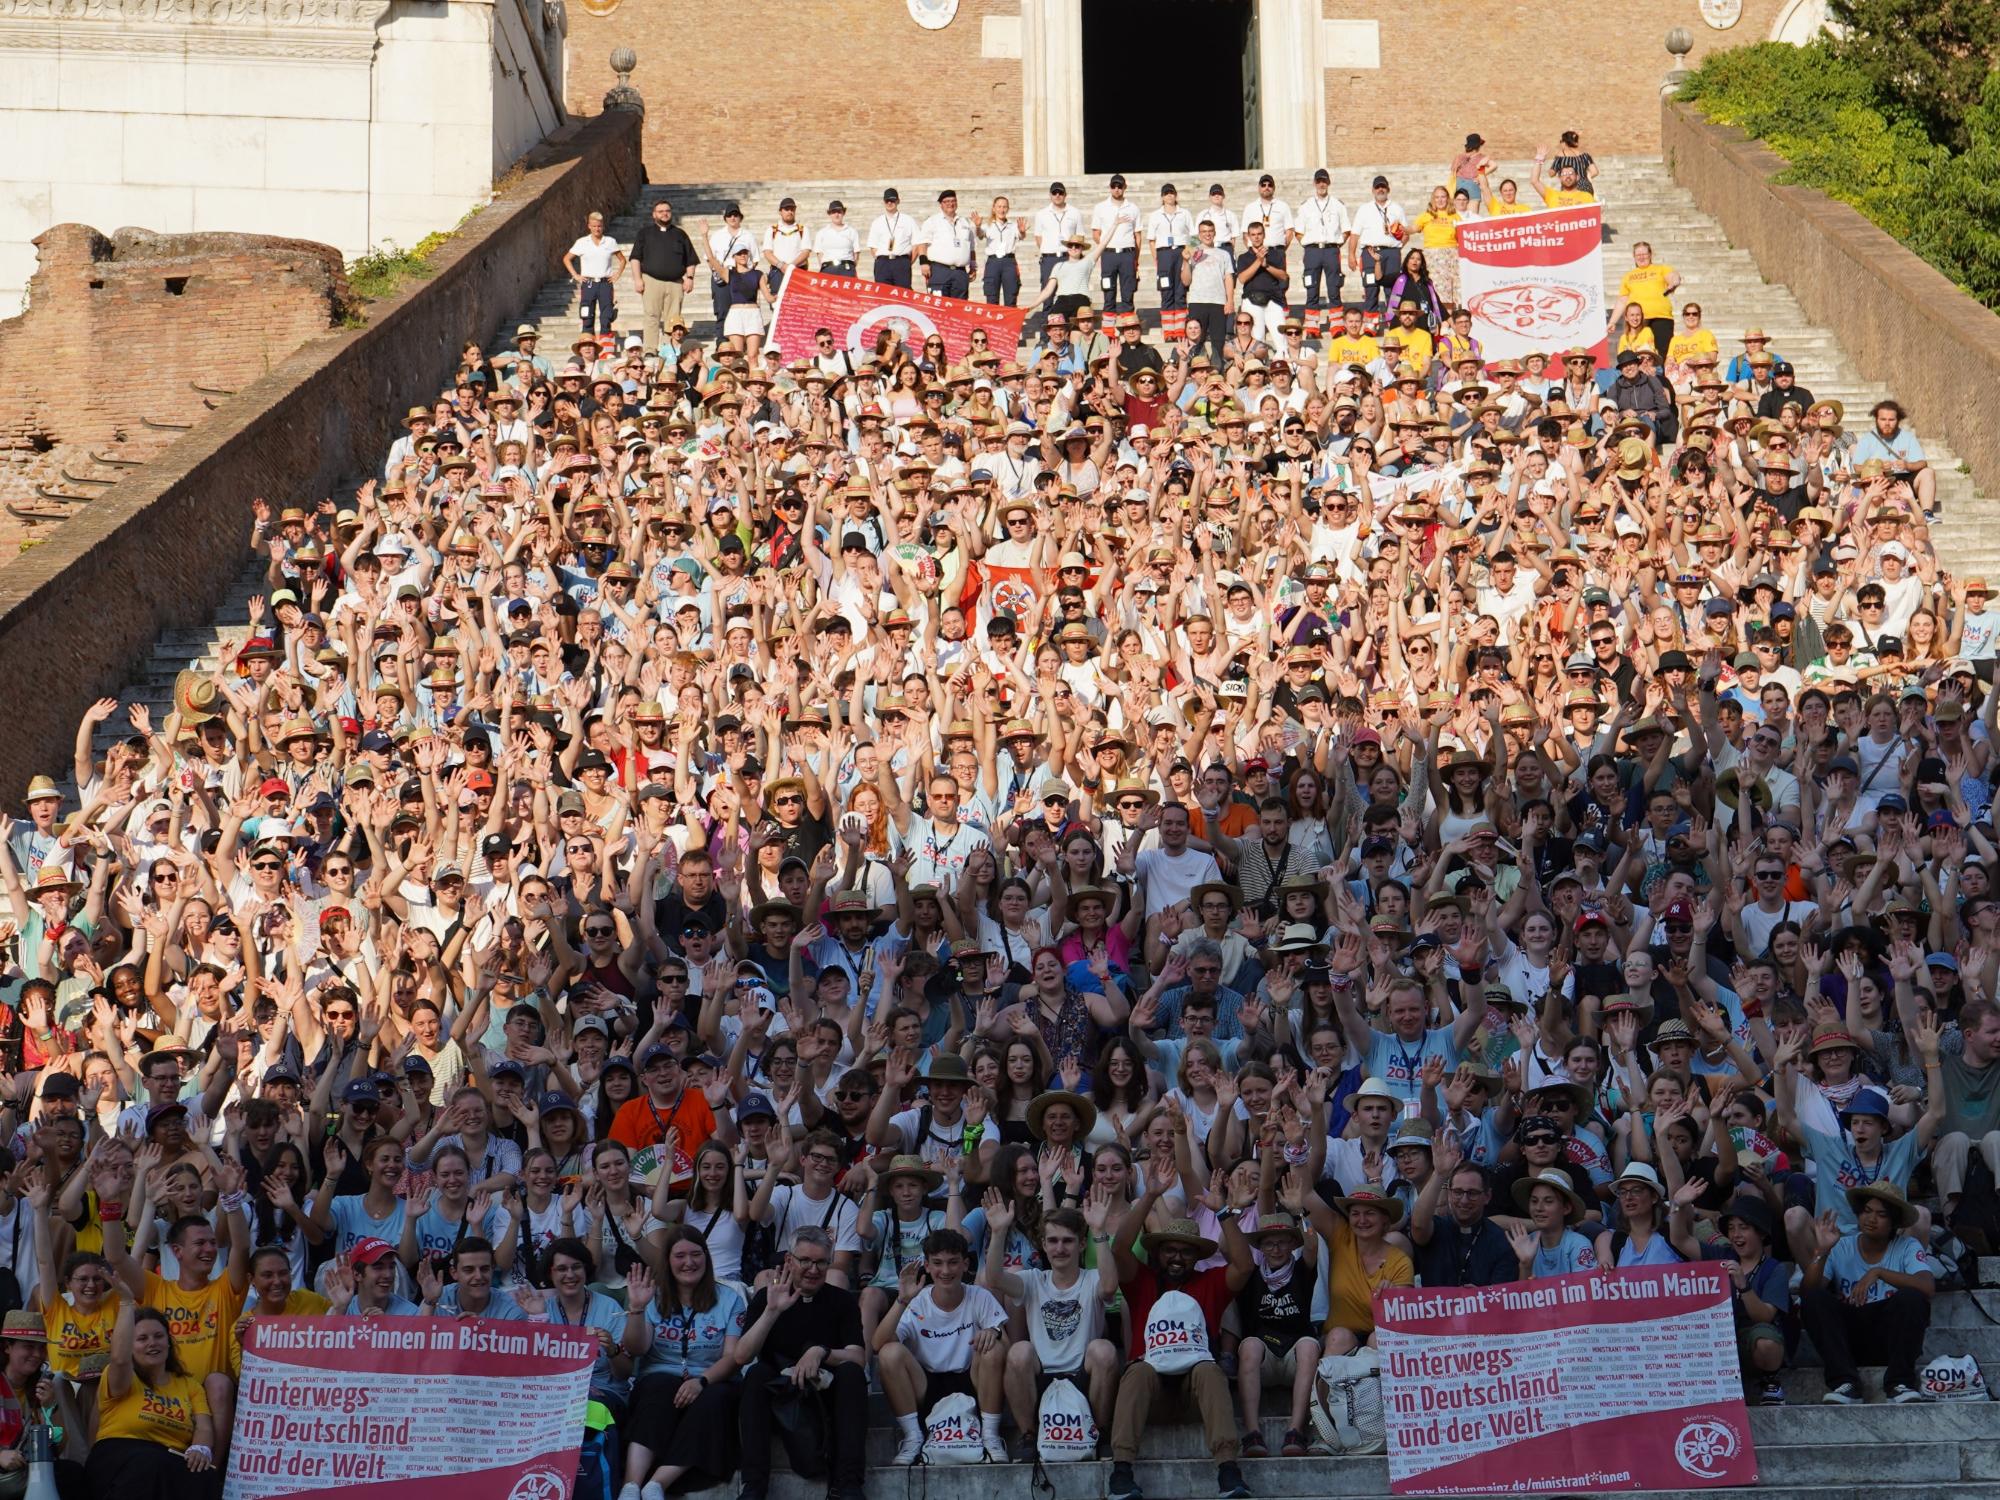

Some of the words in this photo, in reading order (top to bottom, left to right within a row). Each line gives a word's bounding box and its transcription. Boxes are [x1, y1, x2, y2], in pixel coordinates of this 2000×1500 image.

[1464, 240, 1516, 252] Bistum
[1520, 236, 1564, 248] Mainz
[810, 278, 880, 293] PFARREI
[891, 288, 953, 308] ALFRED
[964, 305, 1004, 320] DELP
[1670, 904, 1680, 913] NY
[1386, 1067, 1423, 1080] 204
[1567, 1141, 1590, 1160] 2024
[634, 1150, 655, 1171] ROM
[1837, 1169, 1856, 1187] 20
[1561, 1280, 1587, 1304] im
[1590, 1274, 1659, 1300] Bistum
[1663, 1270, 1720, 1297] Mainz
[164, 1307, 200, 1320] ROM
[169, 1321, 200, 1335] 024
[656, 1326, 696, 1340] 204
[1149, 1320, 1184, 1336] ROM
[59, 1335, 100, 1350] 2024
[430, 1326, 454, 1349] im
[459, 1327, 528, 1354] Bistum
[533, 1333, 590, 1359] Mainz
[1149, 1331, 1188, 1350] 2024
[1390, 1348, 1513, 1378] Unterwegs
[1926, 1369, 1965, 1381] ROM
[1394, 1386, 1415, 1412] in
[1421, 1368, 1560, 1408] Deutschland
[1926, 1379, 1966, 1392] 2024
[249, 1378, 370, 1414] Unterwegs
[142, 1400, 185, 1422] 2024
[1043, 1413, 1081, 1427] ROM
[243, 1410, 264, 1438] in
[271, 1414, 410, 1445] Deutschland
[1044, 1427, 1084, 1440] 2024
[1398, 1419, 1440, 1448] und
[1447, 1416, 1482, 1440] der
[1488, 1407, 1545, 1438] Welt
[239, 1448, 282, 1474] und
[287, 1450, 325, 1476] der
[333, 1452, 386, 1479] Welt
